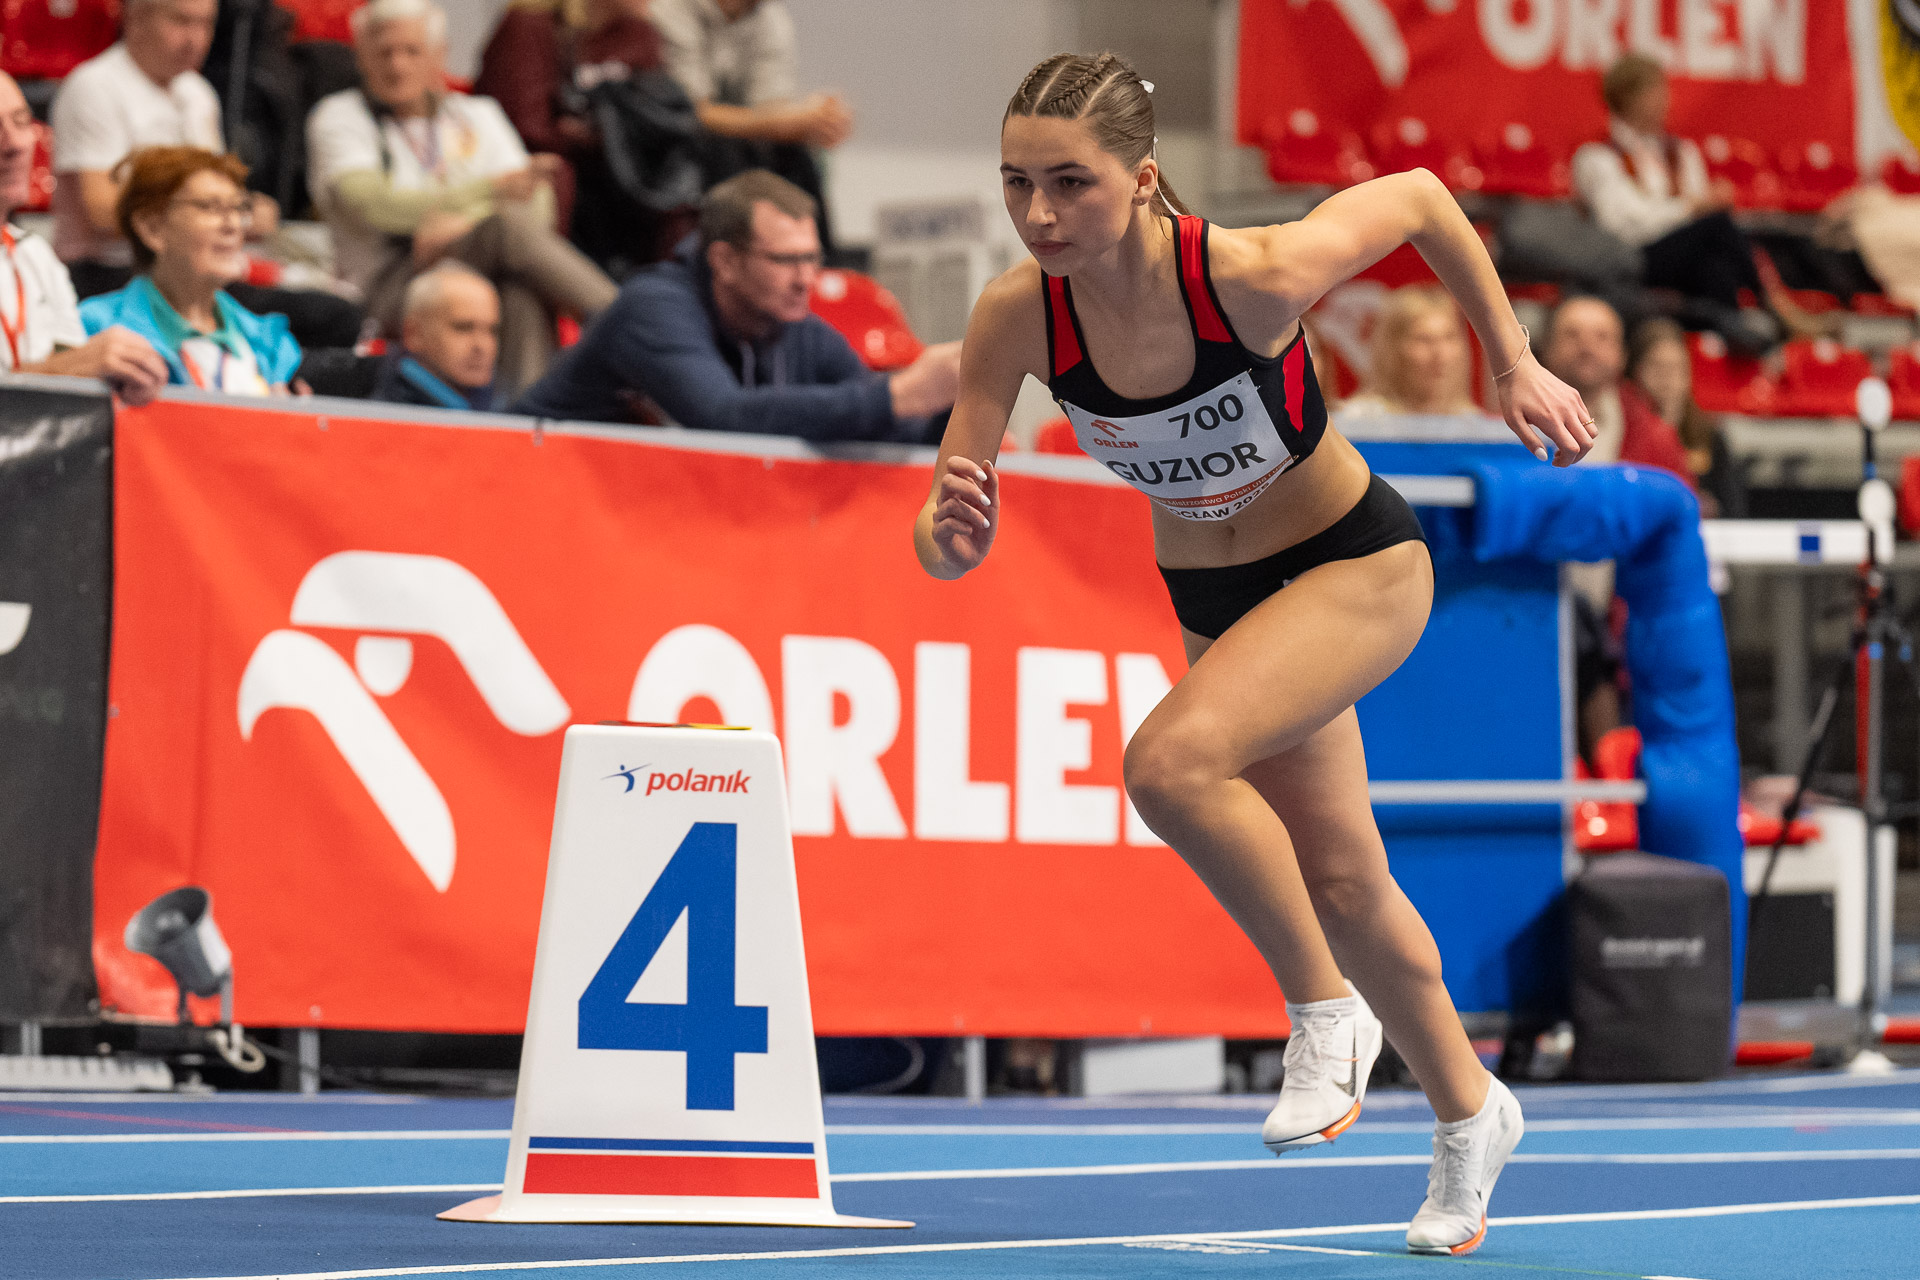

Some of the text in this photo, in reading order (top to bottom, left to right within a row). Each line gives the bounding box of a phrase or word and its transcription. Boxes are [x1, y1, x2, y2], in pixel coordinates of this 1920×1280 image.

[1167, 393, 1244, 439] 700
[1093, 438, 1140, 449] ORLEN
[1105, 442, 1267, 486] GUZIOR
[1167, 496, 1223, 507] Mistrzostwa
[1224, 486, 1251, 501] Polski
[577, 822, 768, 1111] 4
